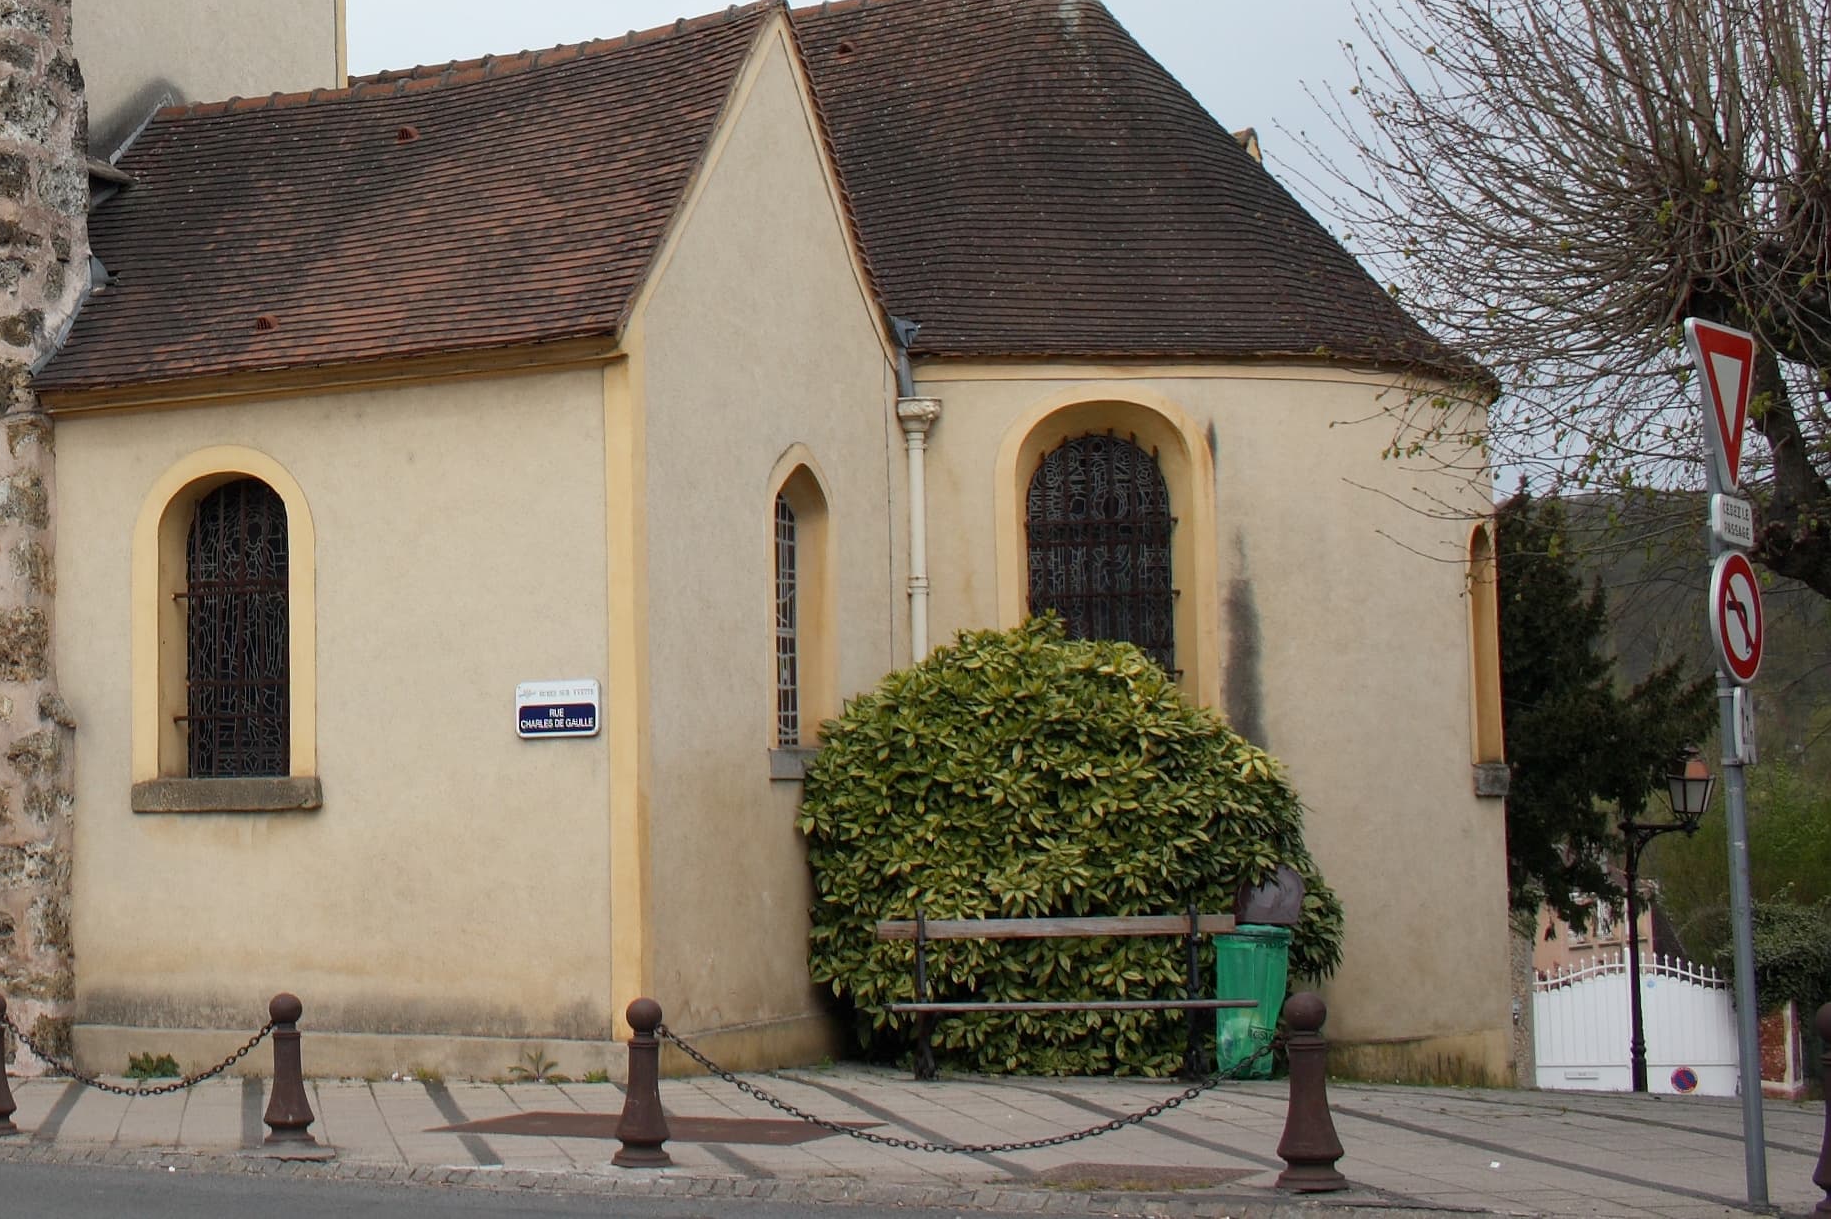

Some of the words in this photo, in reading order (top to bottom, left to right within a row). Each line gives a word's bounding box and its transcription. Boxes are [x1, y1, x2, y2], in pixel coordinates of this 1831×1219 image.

[1724, 521, 1750, 541] PASSAGE
[549, 708, 565, 718] RUE
[520, 718, 553, 729] CHARLES
[554, 718, 565, 728] DE
[565, 717, 594, 728] GAULLE
